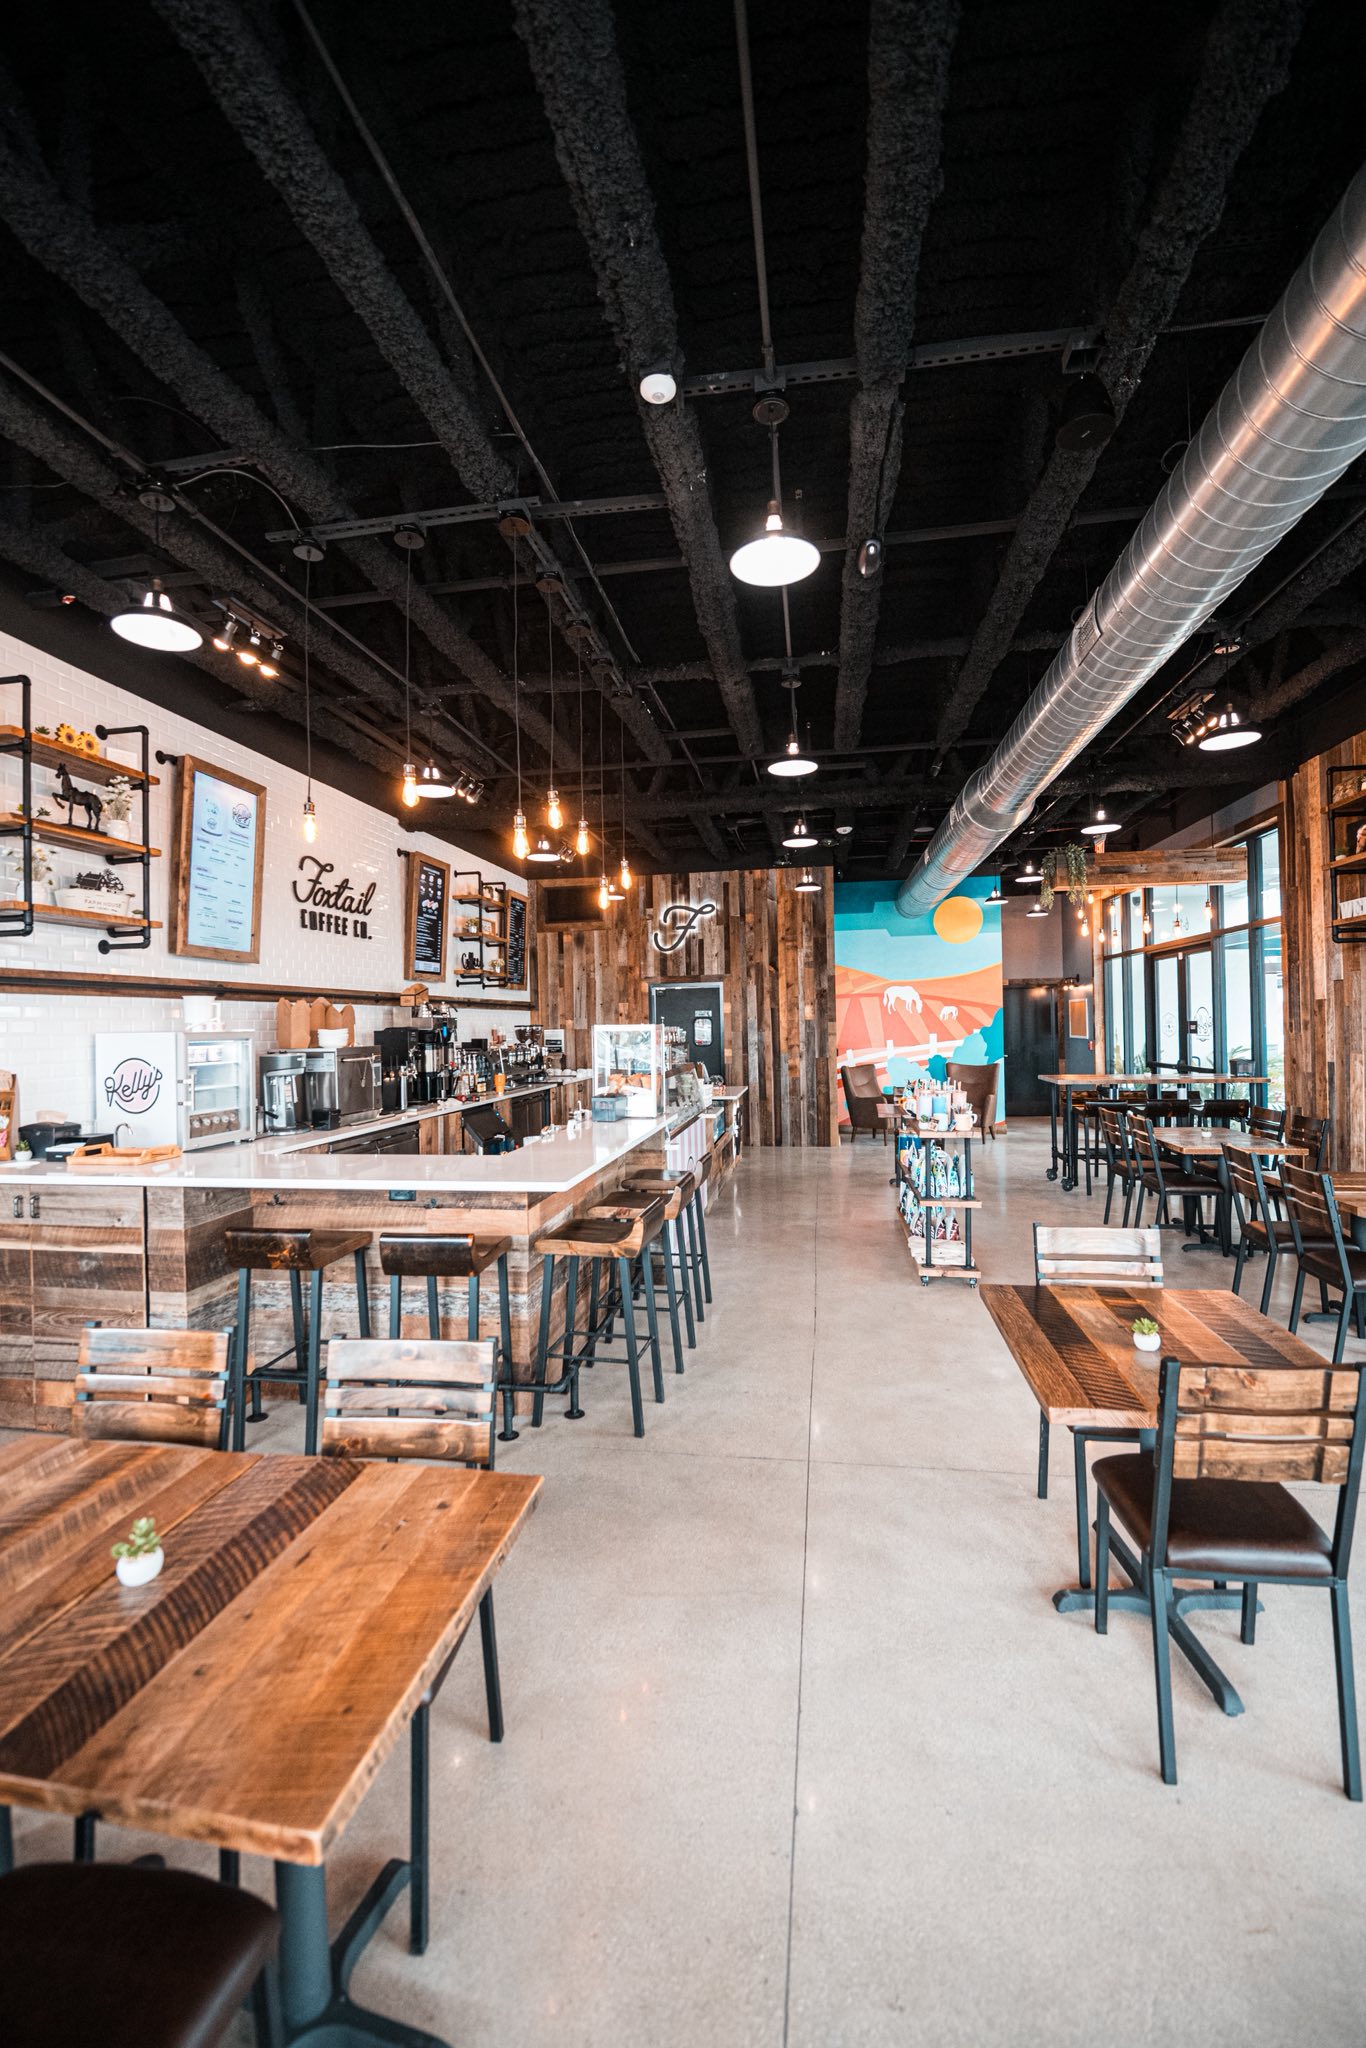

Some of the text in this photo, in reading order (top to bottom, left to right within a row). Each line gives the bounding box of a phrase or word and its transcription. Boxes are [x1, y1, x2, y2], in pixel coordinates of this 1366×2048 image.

[292, 856, 376, 915] Foxtail
[300, 908, 373, 940] COFFEE CO.
[104, 1066, 163, 1107] Kelly's
